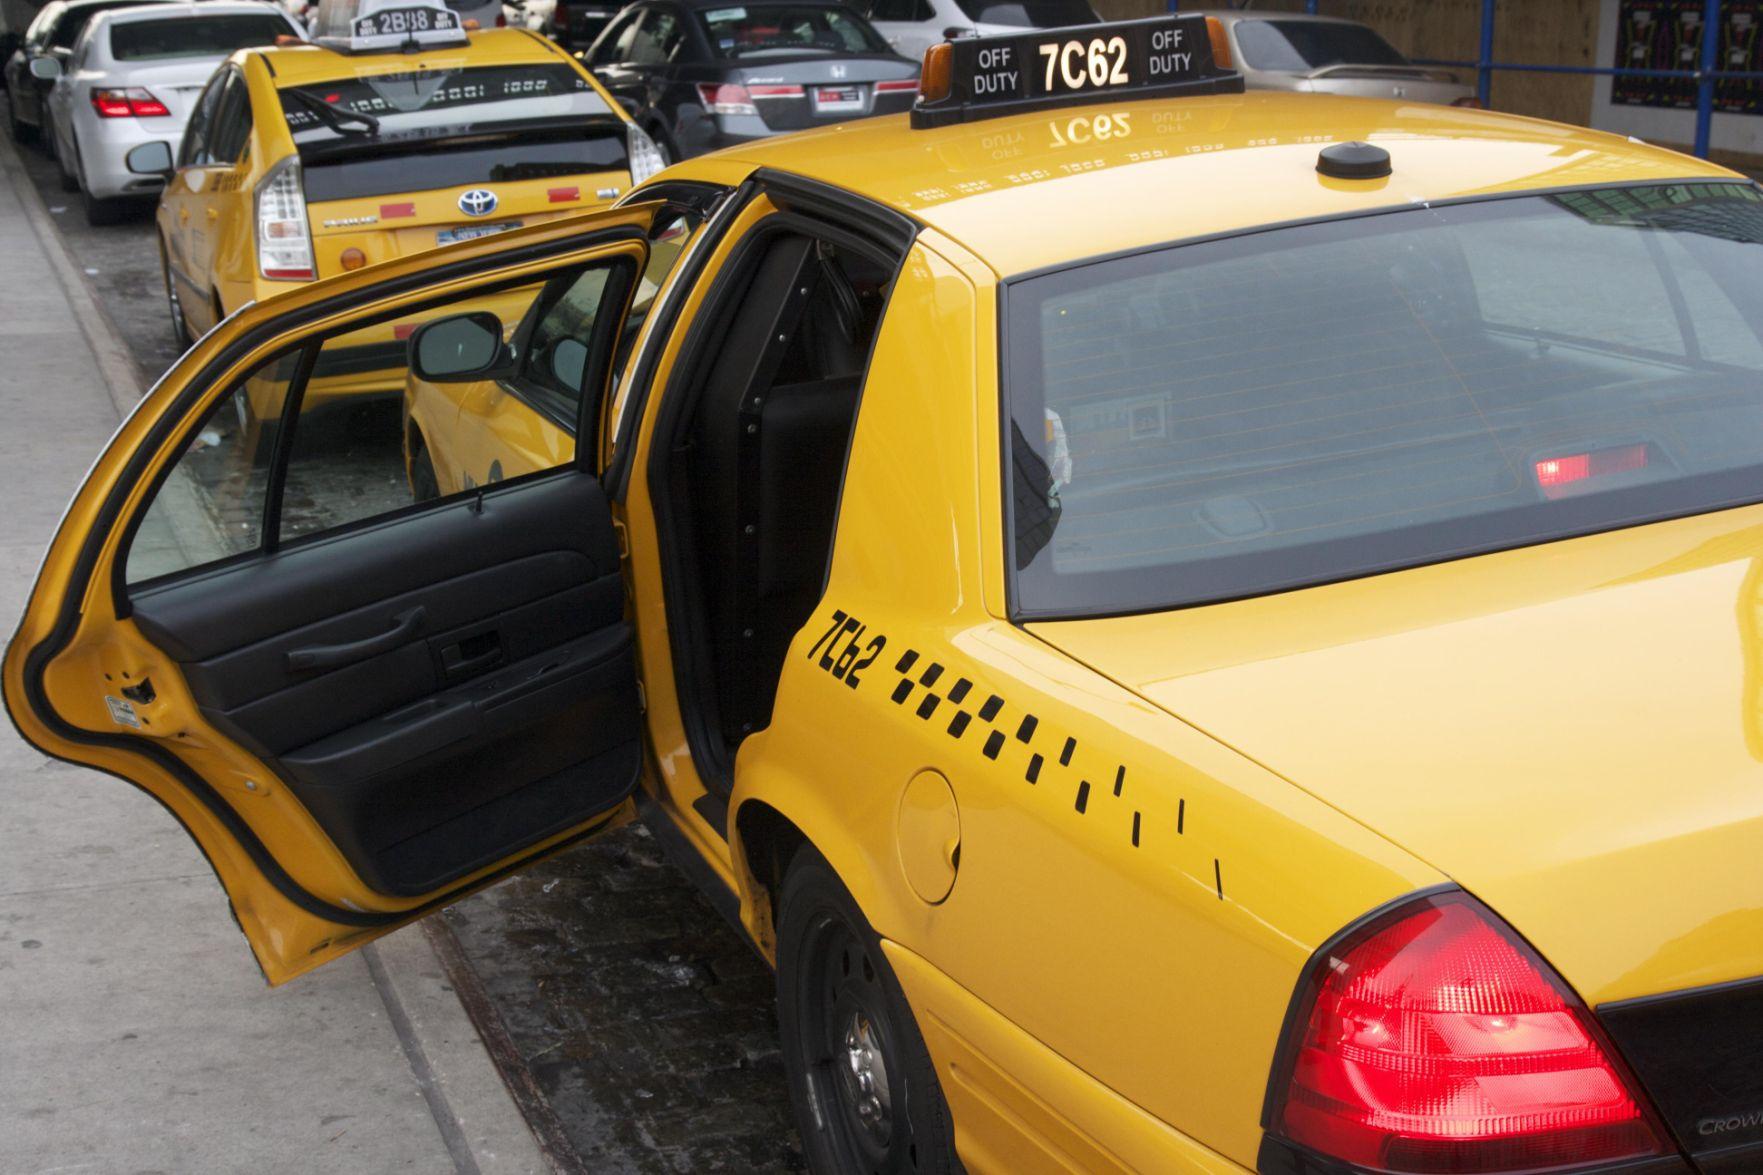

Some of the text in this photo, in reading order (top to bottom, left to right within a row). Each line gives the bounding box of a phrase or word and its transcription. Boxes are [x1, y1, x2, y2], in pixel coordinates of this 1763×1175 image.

[1152, 29, 1184, 51] OFF
[978, 47, 1011, 69] OFF
[1039, 36, 1130, 92] 7C62
[1150, 52, 1193, 75] DUTY
[974, 72, 1019, 95] DUTY
[807, 609, 887, 690] 7C62
